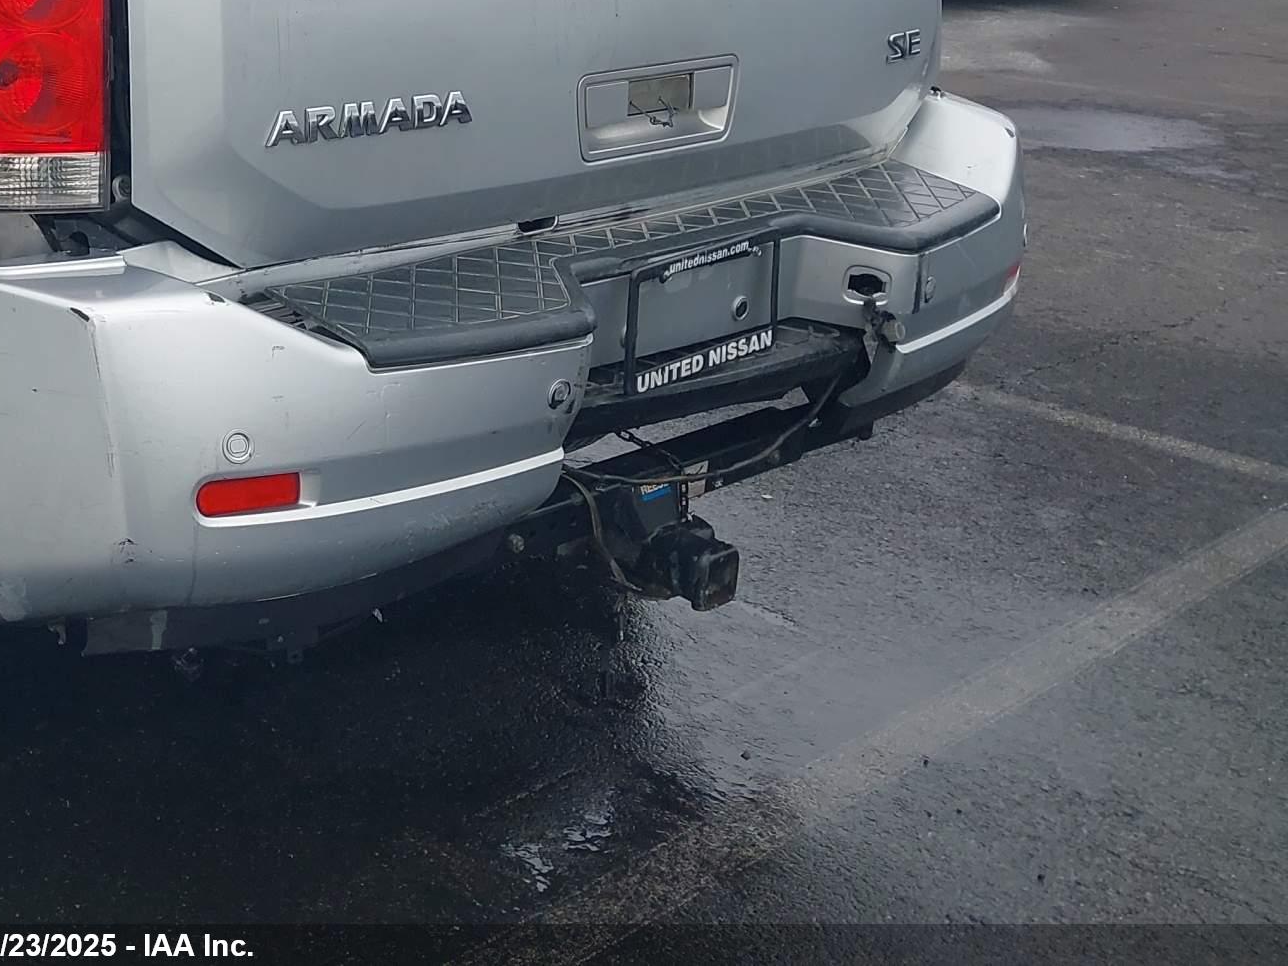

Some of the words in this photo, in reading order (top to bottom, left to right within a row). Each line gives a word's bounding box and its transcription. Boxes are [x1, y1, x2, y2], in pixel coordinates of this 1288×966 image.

[886, 28, 921, 64] SE
[265, 90, 473, 148] ARMADA
[669, 241, 749, 274] unitednissan.com
[637, 355, 704, 393] UNITED
[708, 330, 773, 367] NISSAN
